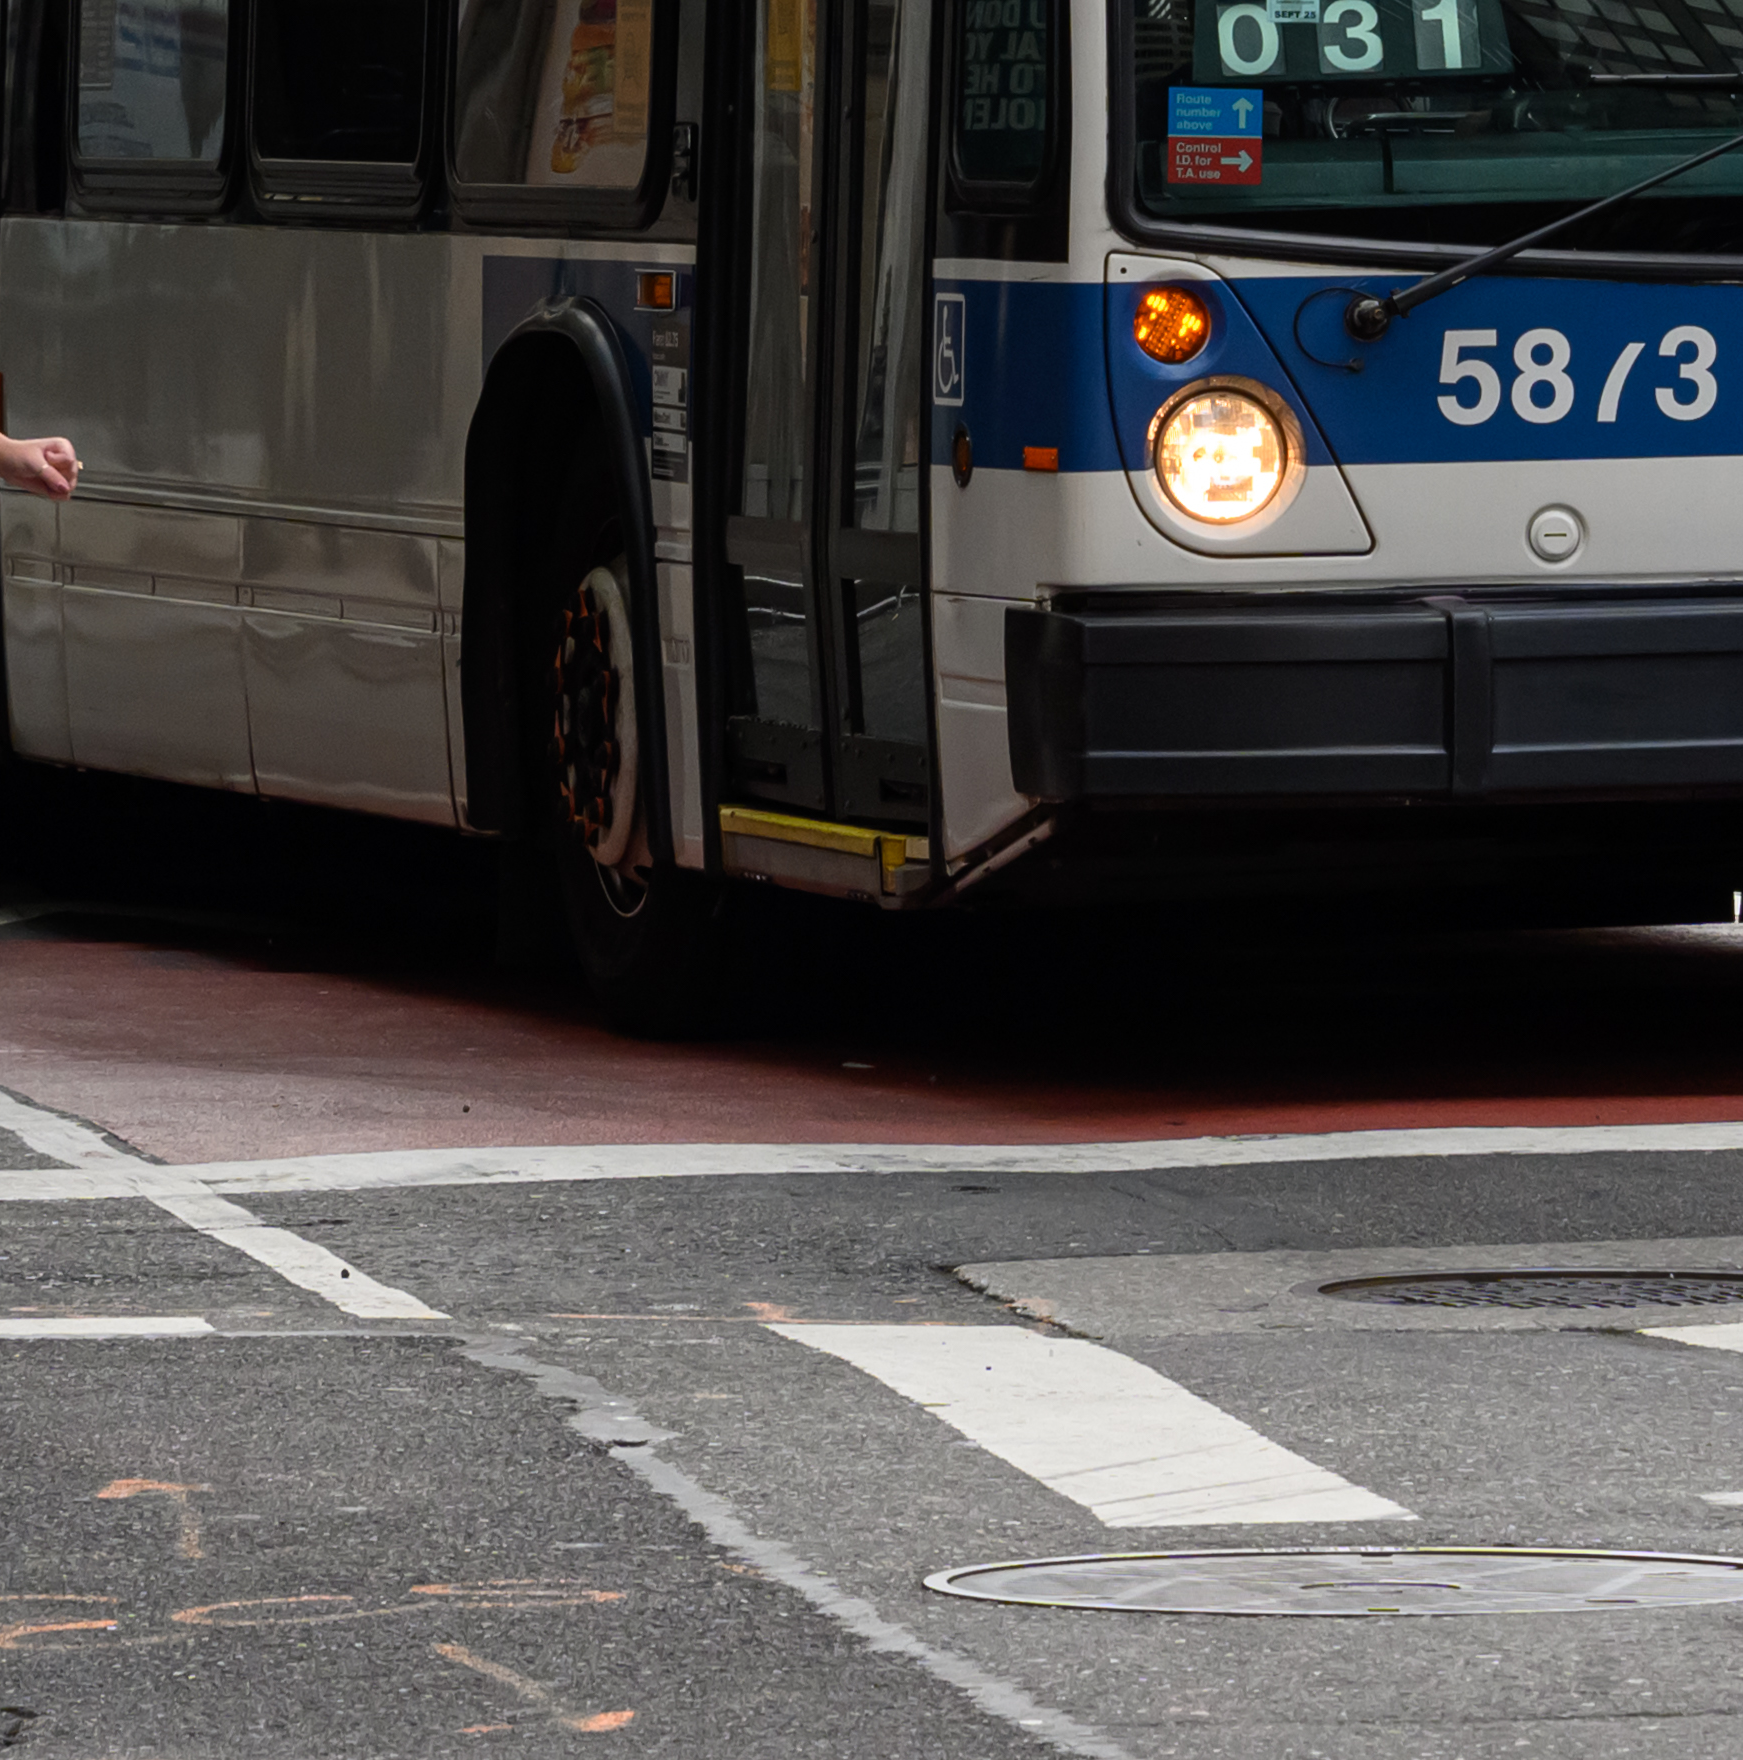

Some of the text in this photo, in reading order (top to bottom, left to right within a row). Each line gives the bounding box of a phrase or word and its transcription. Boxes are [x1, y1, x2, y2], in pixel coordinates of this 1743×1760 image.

[1176, 94, 1211, 105] Route
[1176, 107, 1221, 118] number
[1176, 119, 1212, 130] above
[1176, 142, 1222, 153] Control
[1194, 155, 1212, 166] for
[1199, 169, 1221, 179] use
